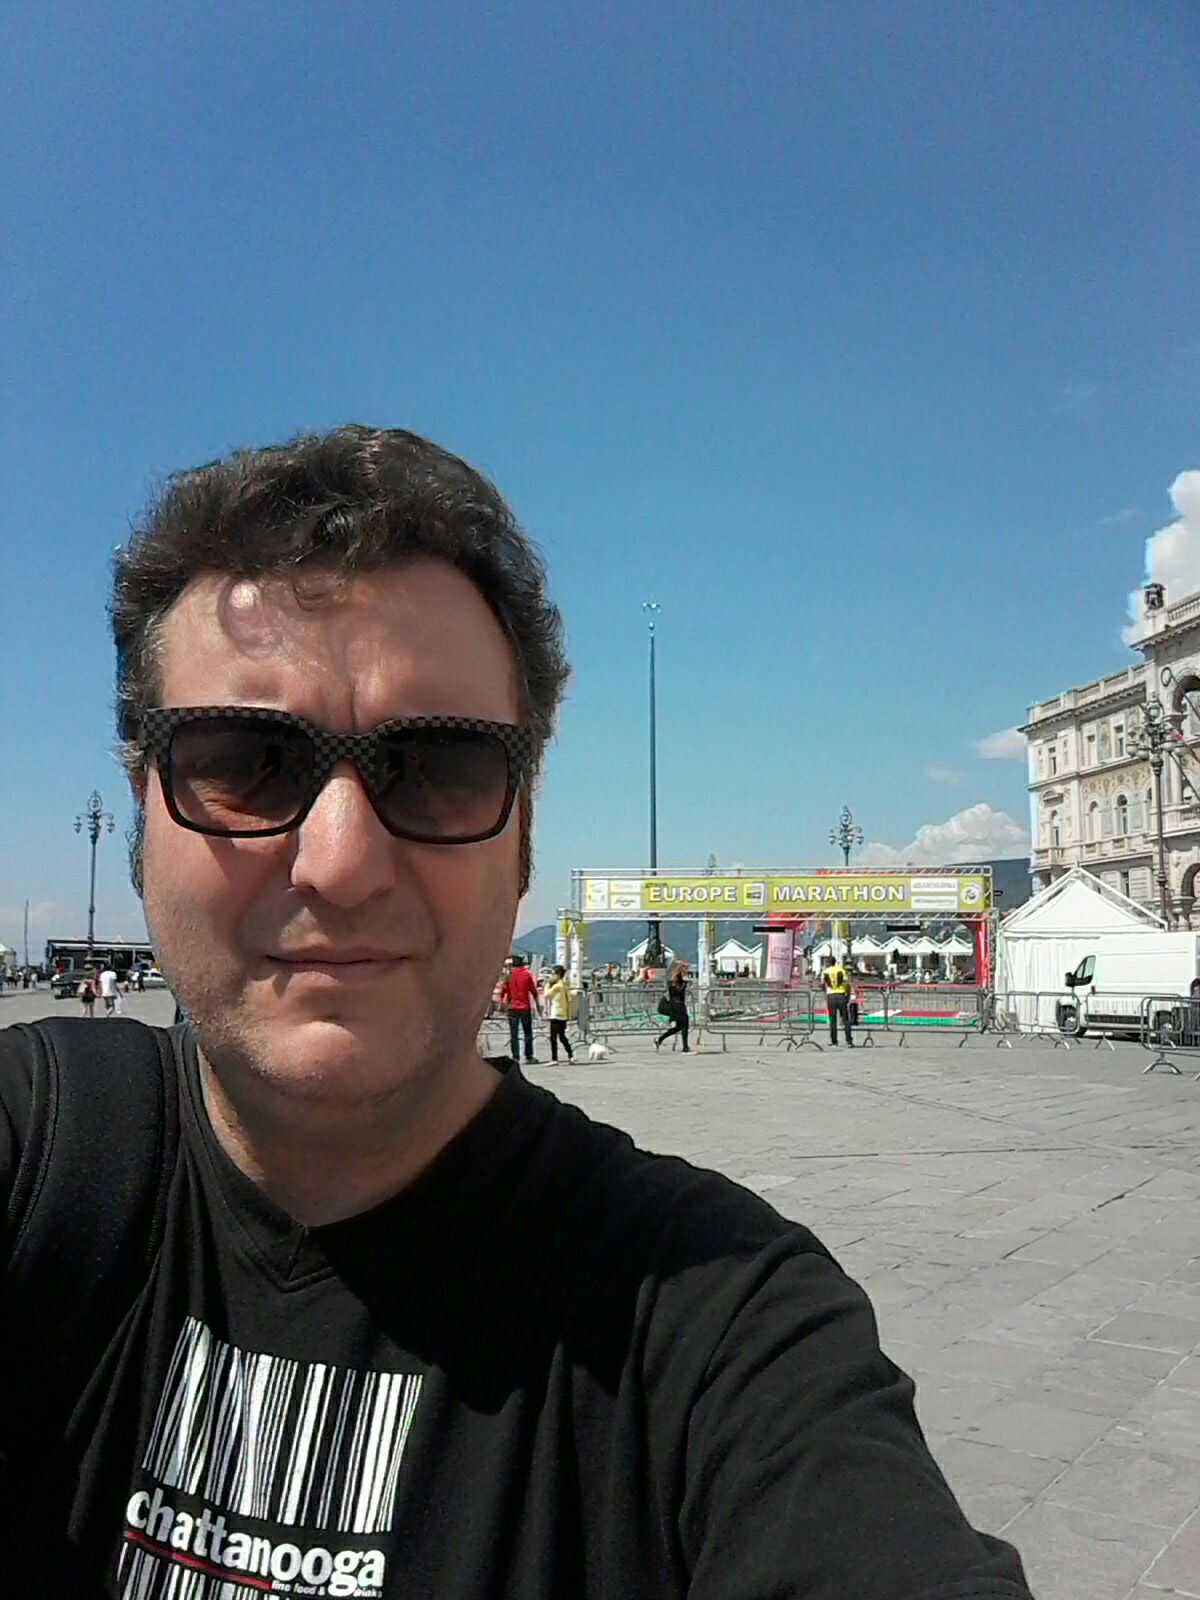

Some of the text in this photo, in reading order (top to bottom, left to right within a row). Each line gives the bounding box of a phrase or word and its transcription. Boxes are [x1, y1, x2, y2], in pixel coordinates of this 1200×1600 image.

[648, 886, 737, 902] EUROPE
[772, 885, 905, 902] MARATHON
[126, 1487, 386, 1597] chattanooga
[271, 1580, 291, 1591] fine
[293, 1582, 316, 1595] food
